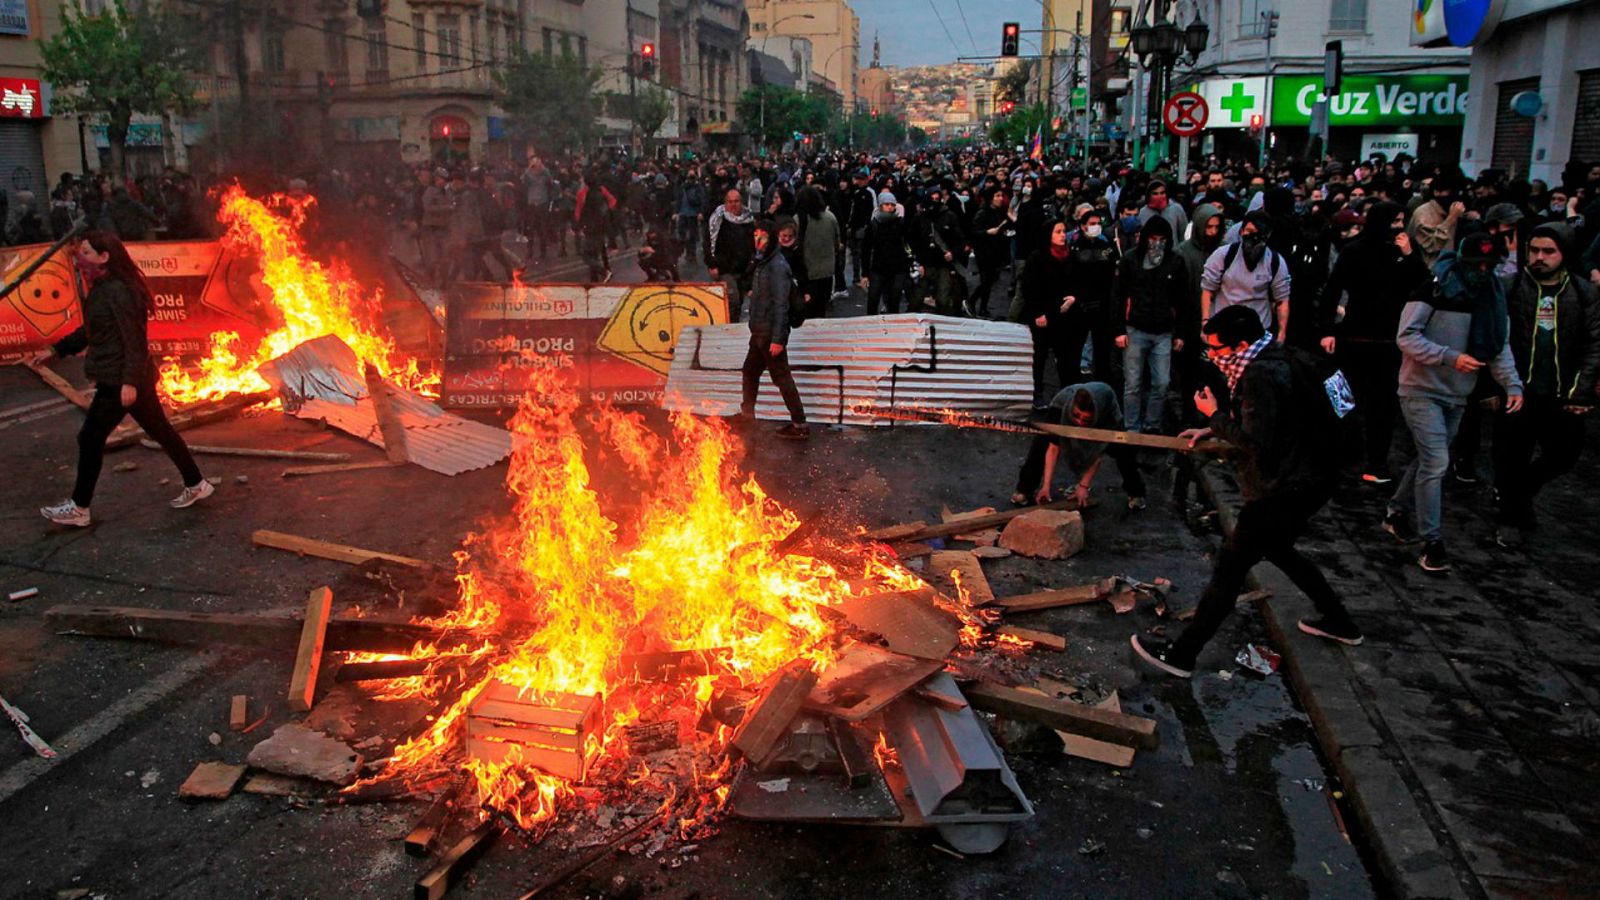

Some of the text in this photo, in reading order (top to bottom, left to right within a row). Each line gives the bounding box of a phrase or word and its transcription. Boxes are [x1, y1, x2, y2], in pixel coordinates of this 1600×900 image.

[1296, 84, 1370, 115] Cuz
[1370, 142, 1409, 150] ABIERTO
[154, 294, 185, 307] PRO
[473, 338, 575, 353] PROGRSO
